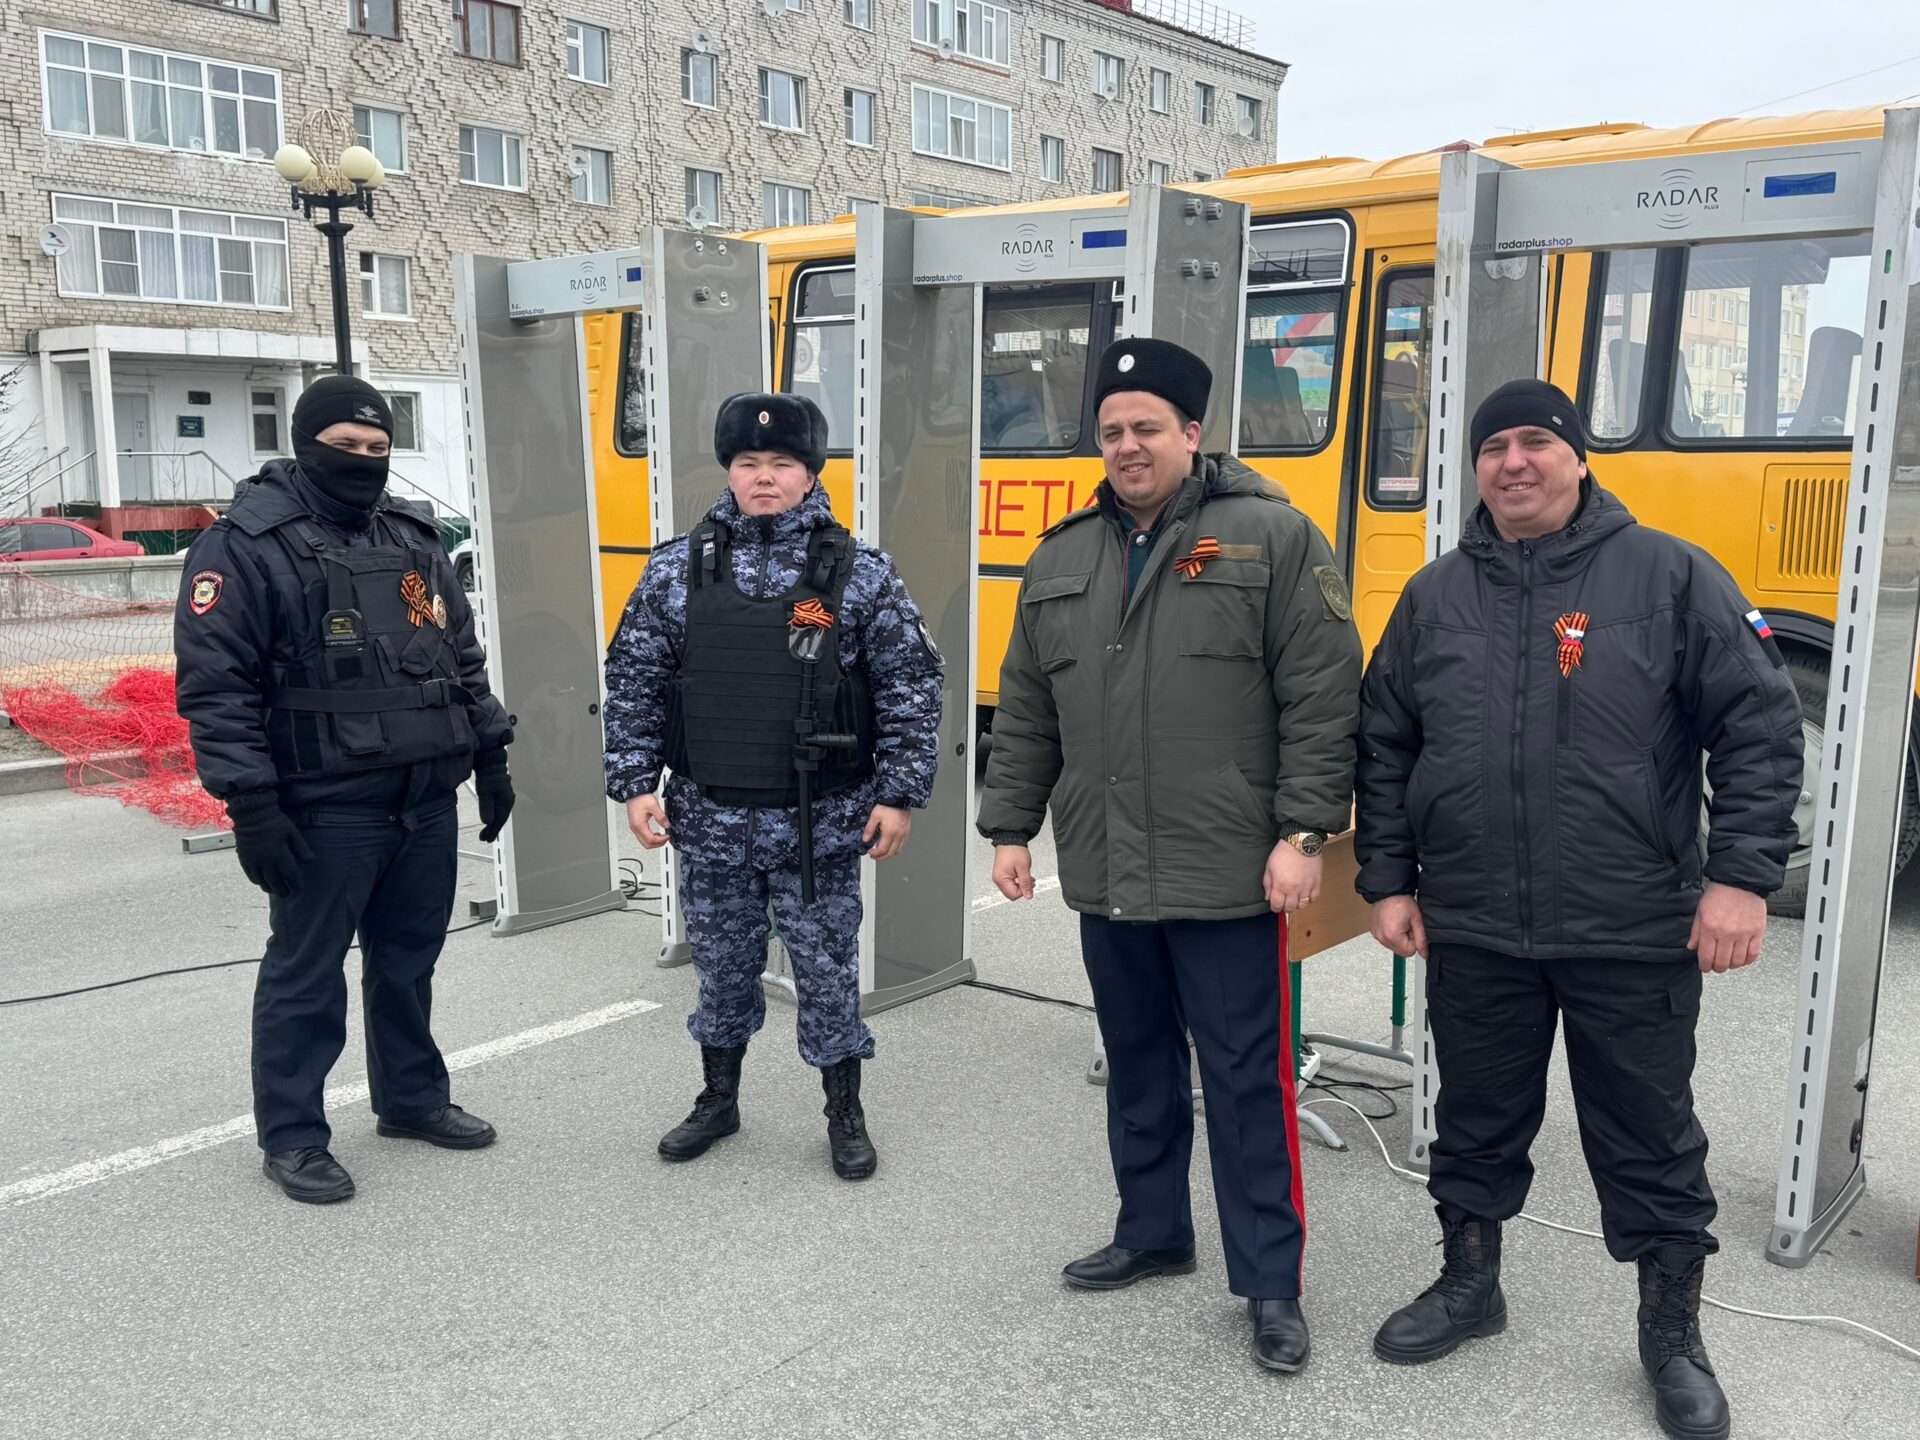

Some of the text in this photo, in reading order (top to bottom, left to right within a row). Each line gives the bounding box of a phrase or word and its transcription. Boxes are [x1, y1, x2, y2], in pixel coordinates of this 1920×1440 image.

[1637, 186, 1718, 209] RADAR
[1002, 239, 1053, 255] RADAR
[1498, 236, 1573, 250] radarplus.shop
[570, 276, 607, 291] RADAR
[914, 274, 962, 283] radarplus.shop
